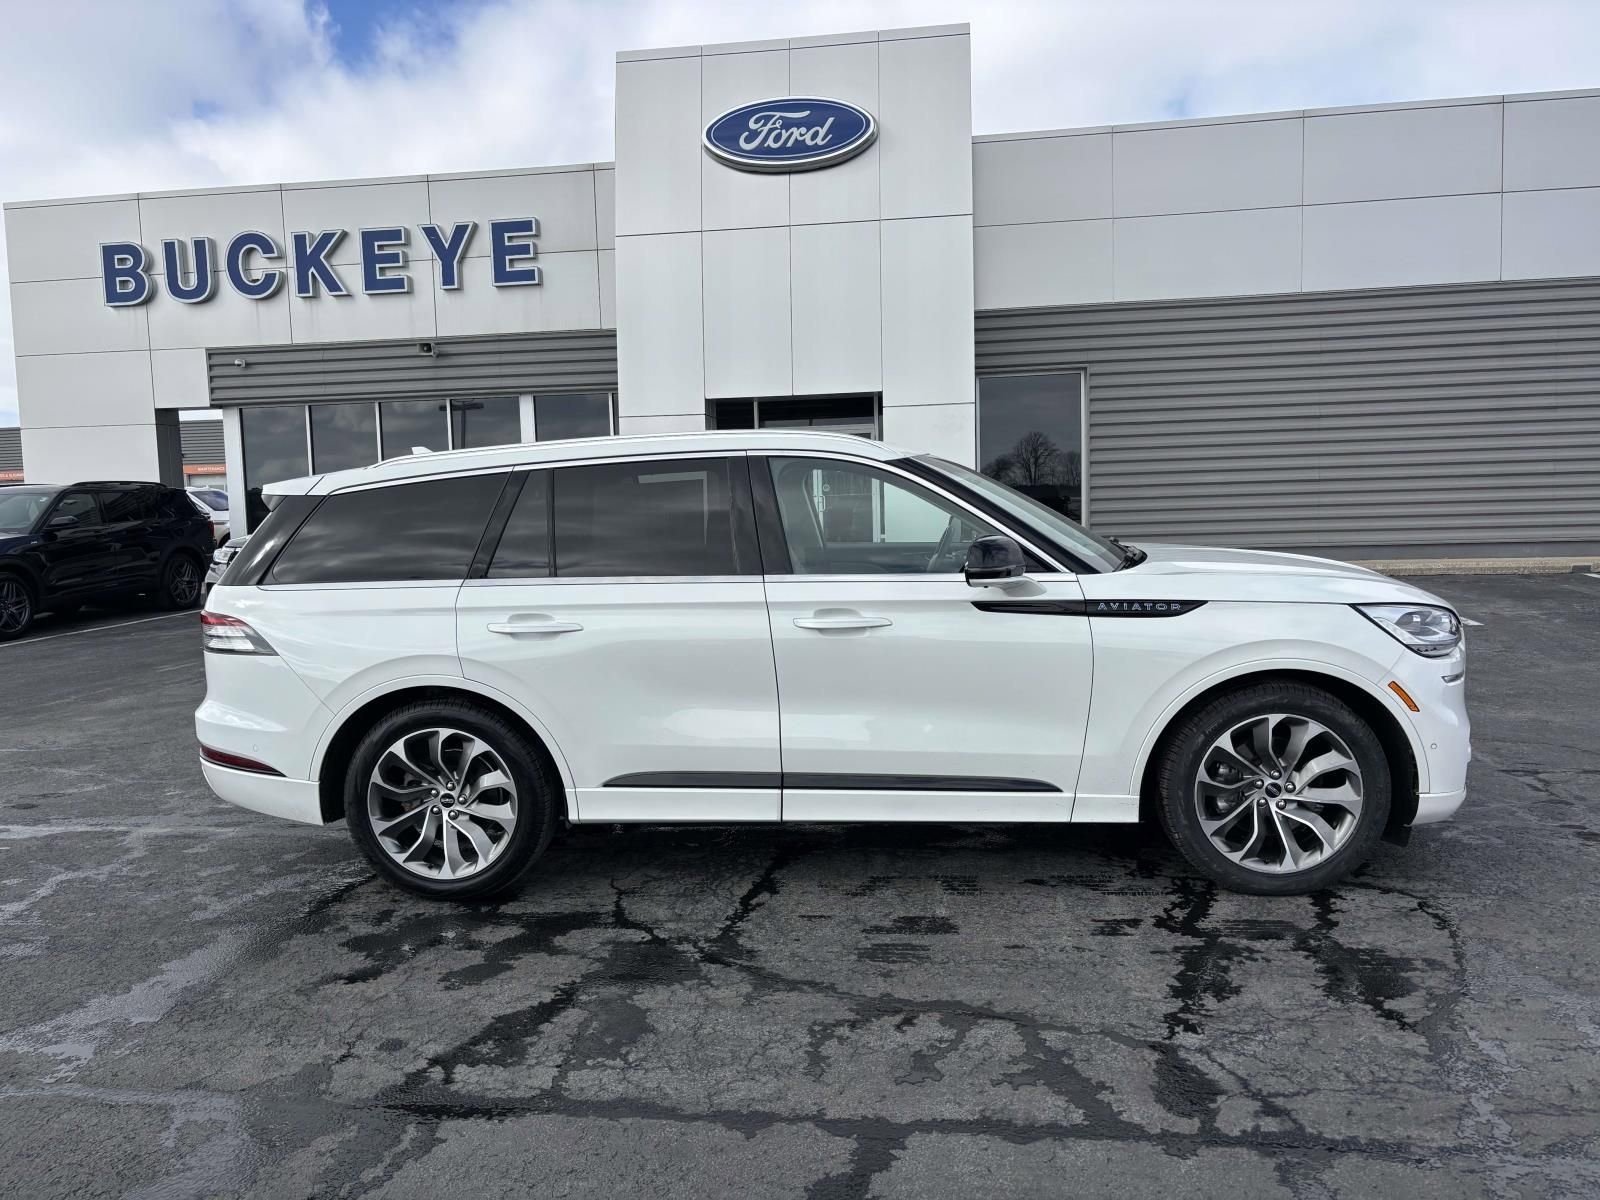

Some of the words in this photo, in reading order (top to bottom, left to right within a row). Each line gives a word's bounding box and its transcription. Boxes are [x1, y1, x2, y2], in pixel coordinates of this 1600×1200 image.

[738, 110, 835, 151] Ford
[100, 216, 541, 308] BUCKEYE
[1097, 602, 1181, 611] AVIATOR
